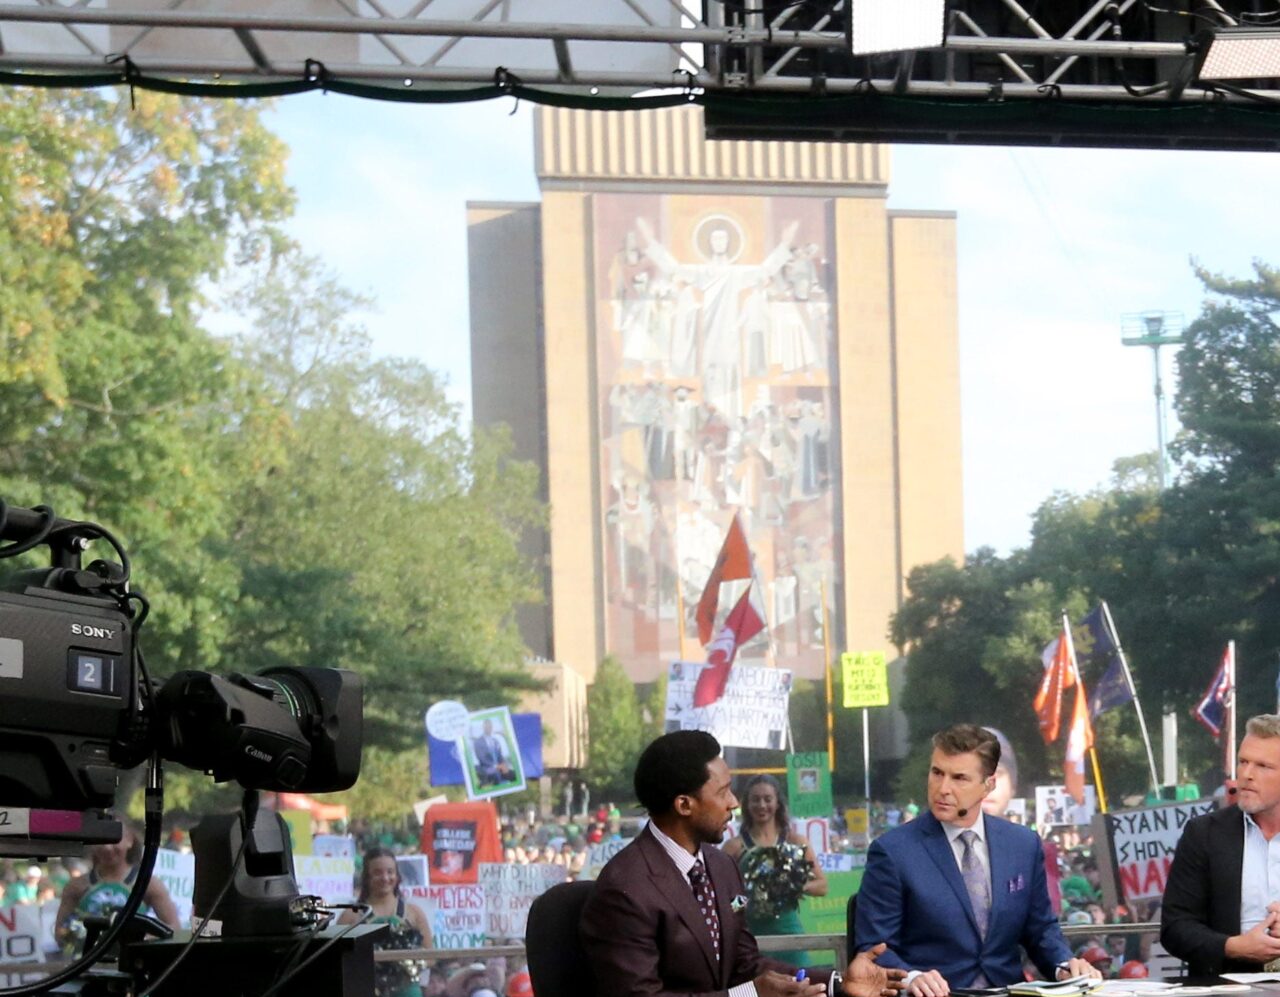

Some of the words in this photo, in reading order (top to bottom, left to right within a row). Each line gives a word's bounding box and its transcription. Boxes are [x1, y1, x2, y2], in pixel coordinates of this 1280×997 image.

[71, 623, 116, 640] SONY
[83, 663, 96, 683] 2
[244, 744, 273, 763] Canon
[1113, 808, 1168, 835] RYAN
[1119, 840, 1176, 863] SHOW
